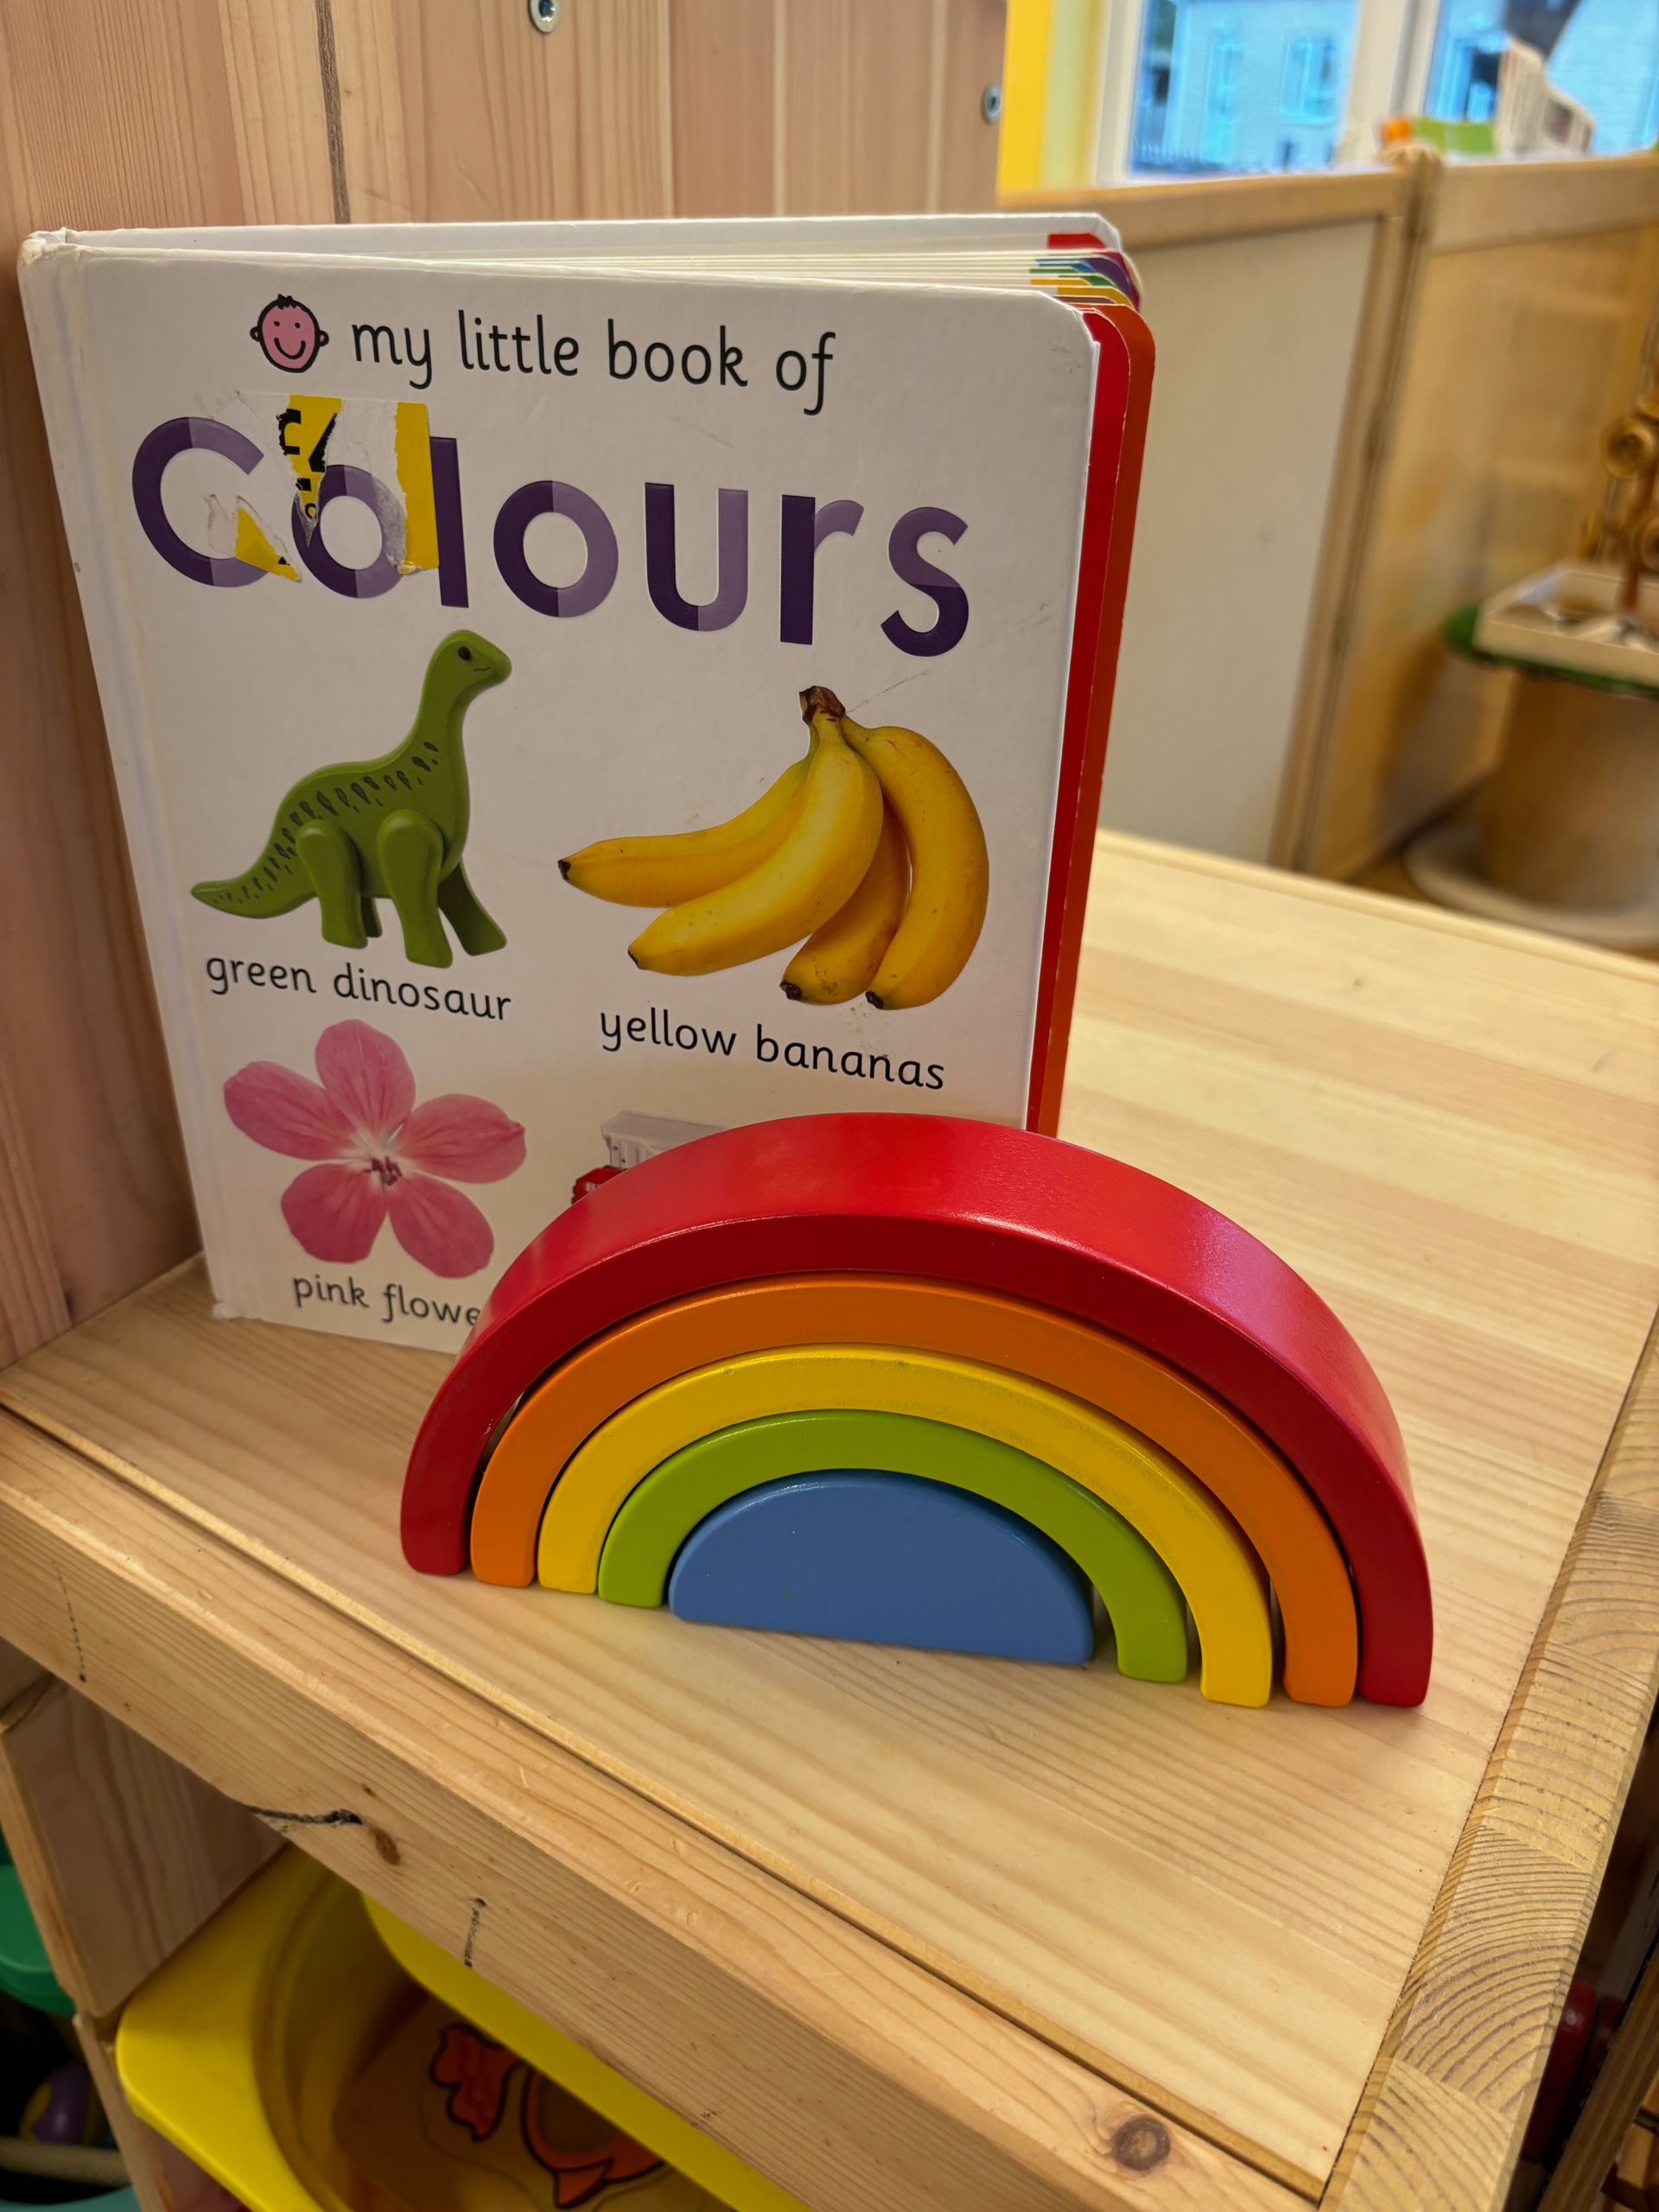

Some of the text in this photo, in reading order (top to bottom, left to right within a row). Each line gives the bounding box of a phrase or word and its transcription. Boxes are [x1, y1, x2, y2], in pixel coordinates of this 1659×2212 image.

[351, 308, 836, 416] my little book of
[131, 416, 969, 658] Colours
[206, 957, 512, 1020] green dinosaur
[600, 1007, 944, 1090] yellow bananas
[293, 1274, 480, 1326] pink flowe
